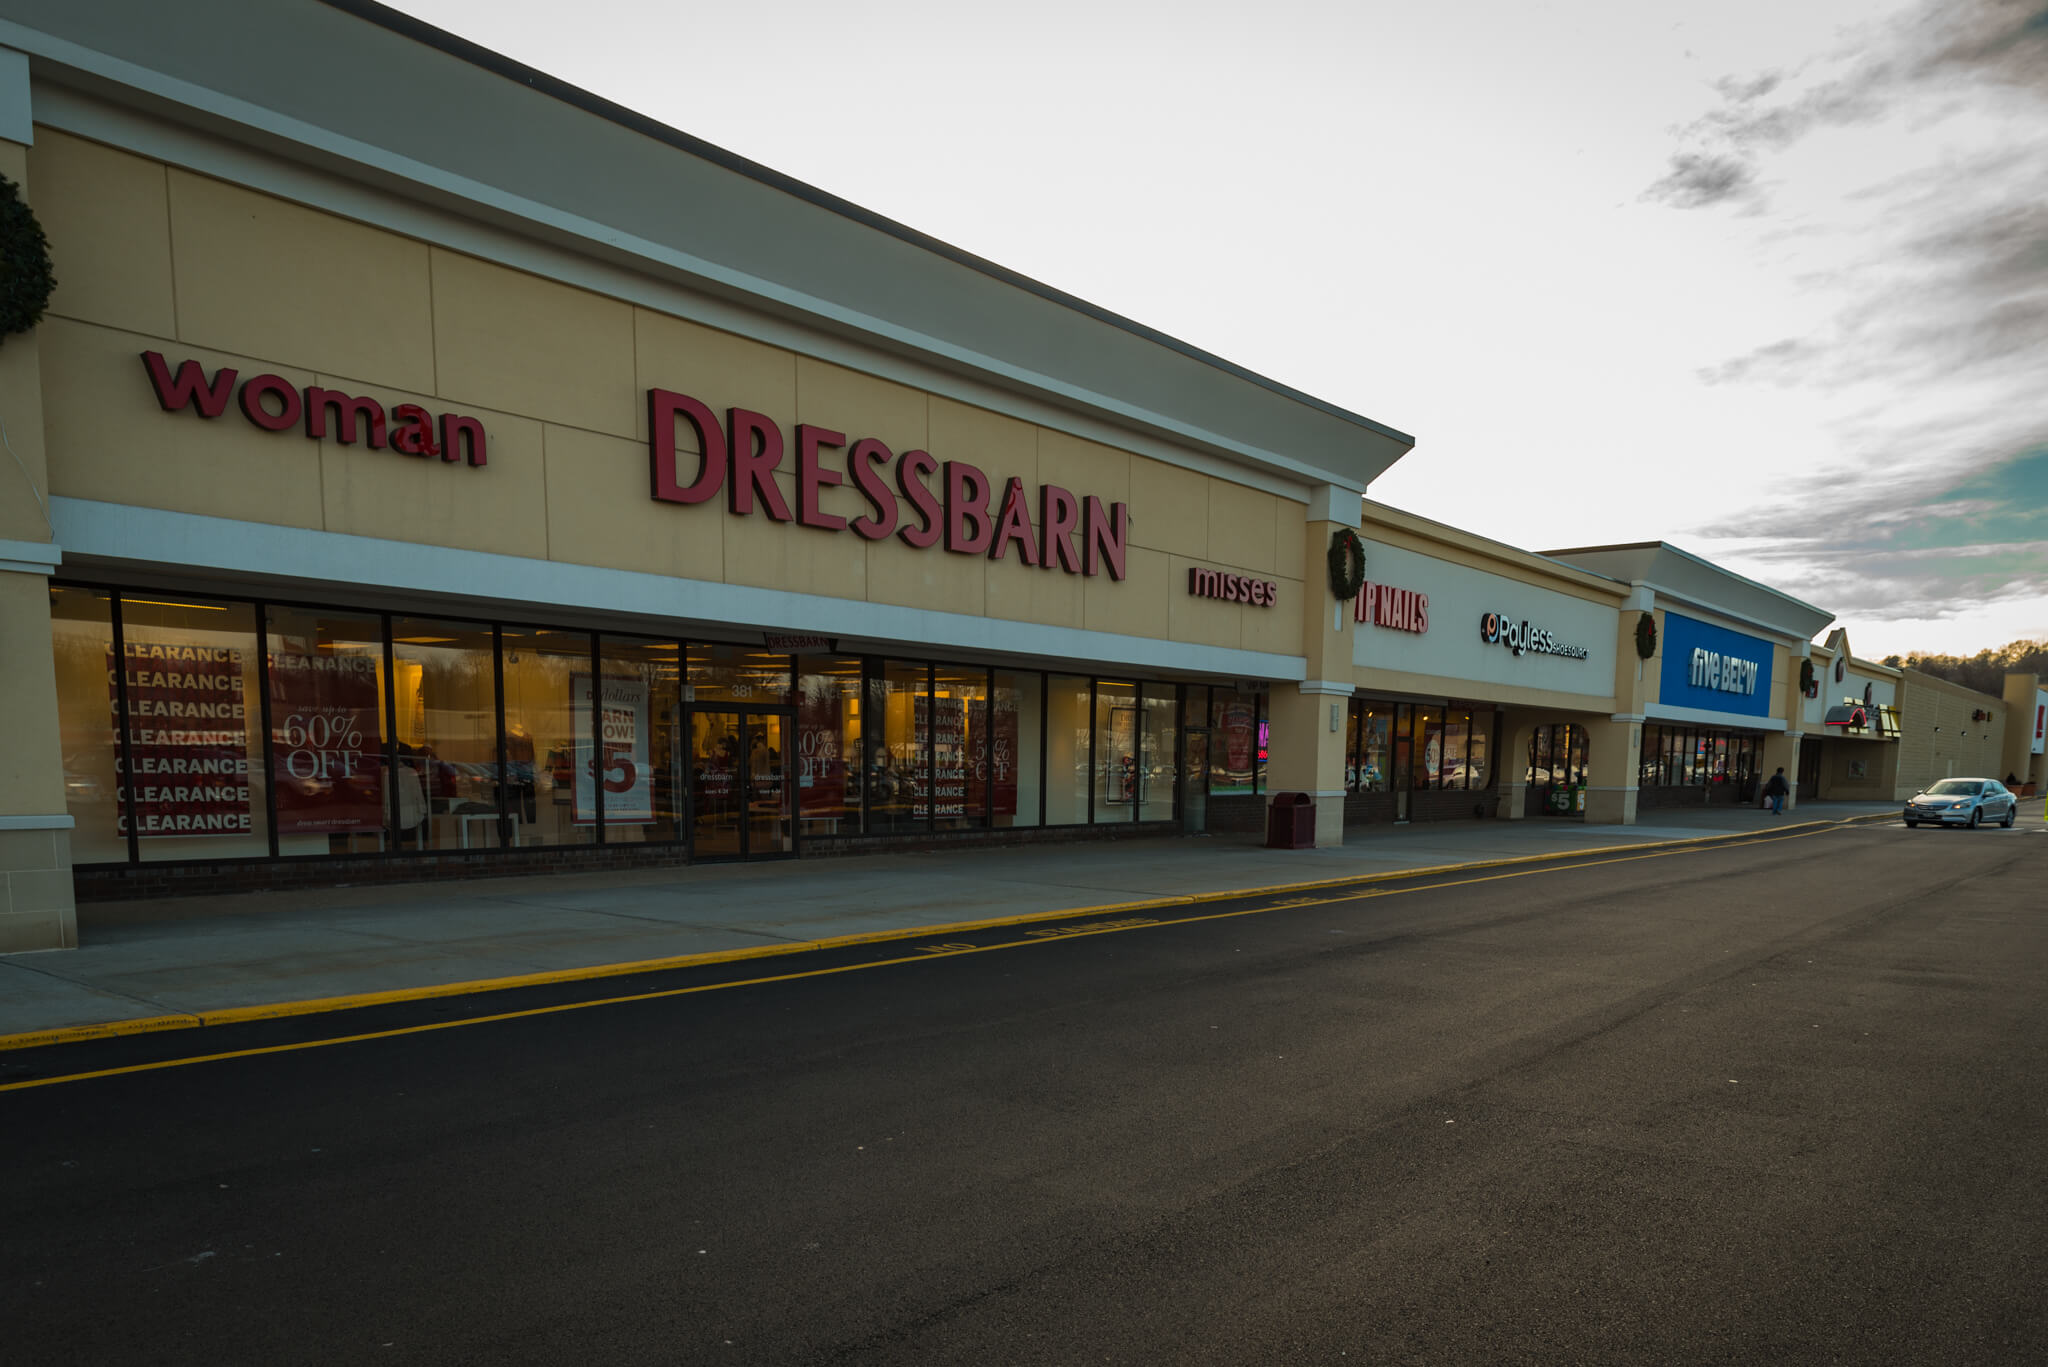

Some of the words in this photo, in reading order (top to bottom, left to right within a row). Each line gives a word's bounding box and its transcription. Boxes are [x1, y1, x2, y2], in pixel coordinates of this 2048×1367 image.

[140, 350, 487, 466] woman
[648, 388, 1127, 582] DRESSBARN
[1188, 567, 1277, 608] misses
[1354, 581, 1376, 623] IP
[1378, 585, 1429, 633] NAILS
[767, 636, 829, 649] DRESSBARN
[1500, 614, 1553, 656] Payless
[1552, 642, 1590, 660] SHOESOURC
[1721, 655, 1759, 696] BELOW
[731, 684, 752, 698] 381
[602, 709, 633, 724] ARN
[283, 714, 363, 750] 60%
[603, 725, 634, 739] OW!
[914, 732, 964, 745] CLERANCE
[798, 730, 833, 756] 0%
[286, 749, 363, 780] OFF
[914, 750, 965, 762] CLERANCE
[914, 767, 965, 780] CLERANCE
[913, 786, 965, 798] CLERANCE
[912, 803, 965, 815] CLERANCE
